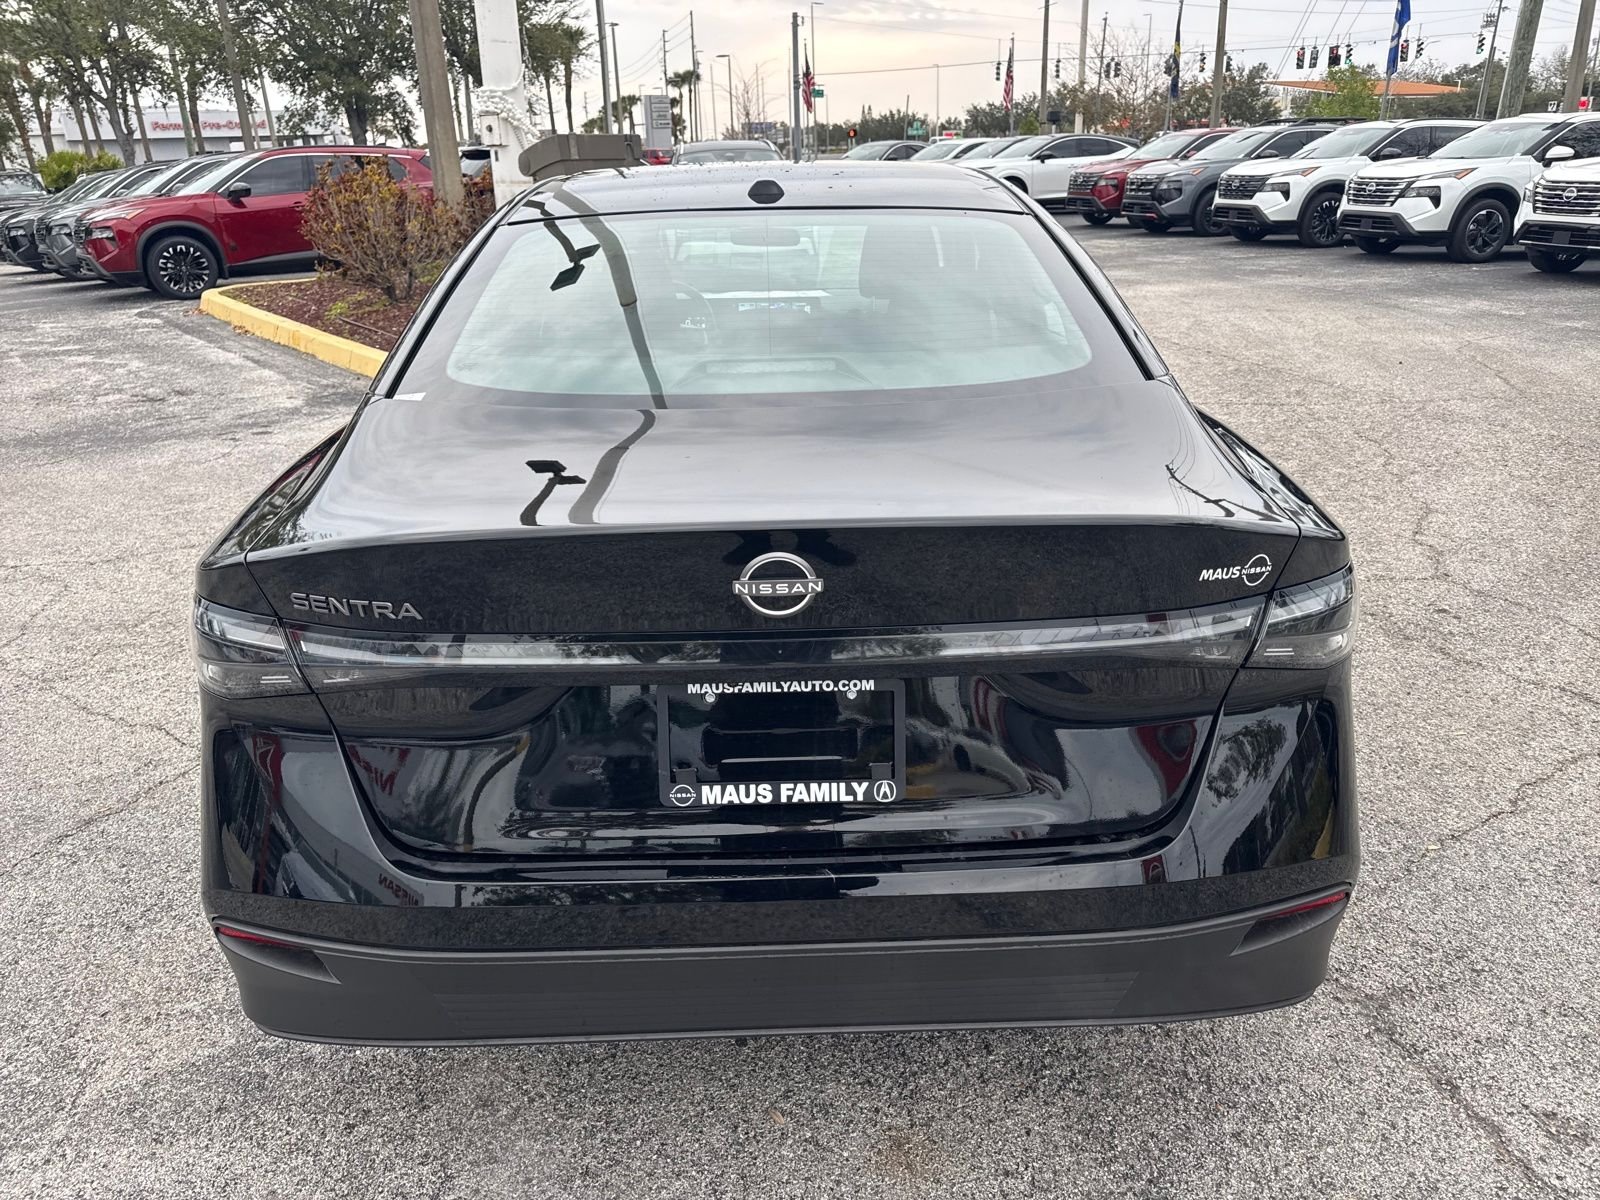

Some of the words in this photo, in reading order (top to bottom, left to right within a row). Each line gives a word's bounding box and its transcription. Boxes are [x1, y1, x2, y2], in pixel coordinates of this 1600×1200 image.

[151, 121, 195, 131] Ferm
[201, 120, 267, 130] Pre-Owd
[1199, 566, 1242, 581] MAUS
[1242, 565, 1272, 574] NISSAN
[735, 581, 822, 594] NISSAN
[290, 592, 423, 620] SENTRA
[687, 679, 875, 694] MAUSFAMILYAUTO.COM
[701, 784, 773, 805] MAUS
[780, 781, 869, 803] FAMILY
